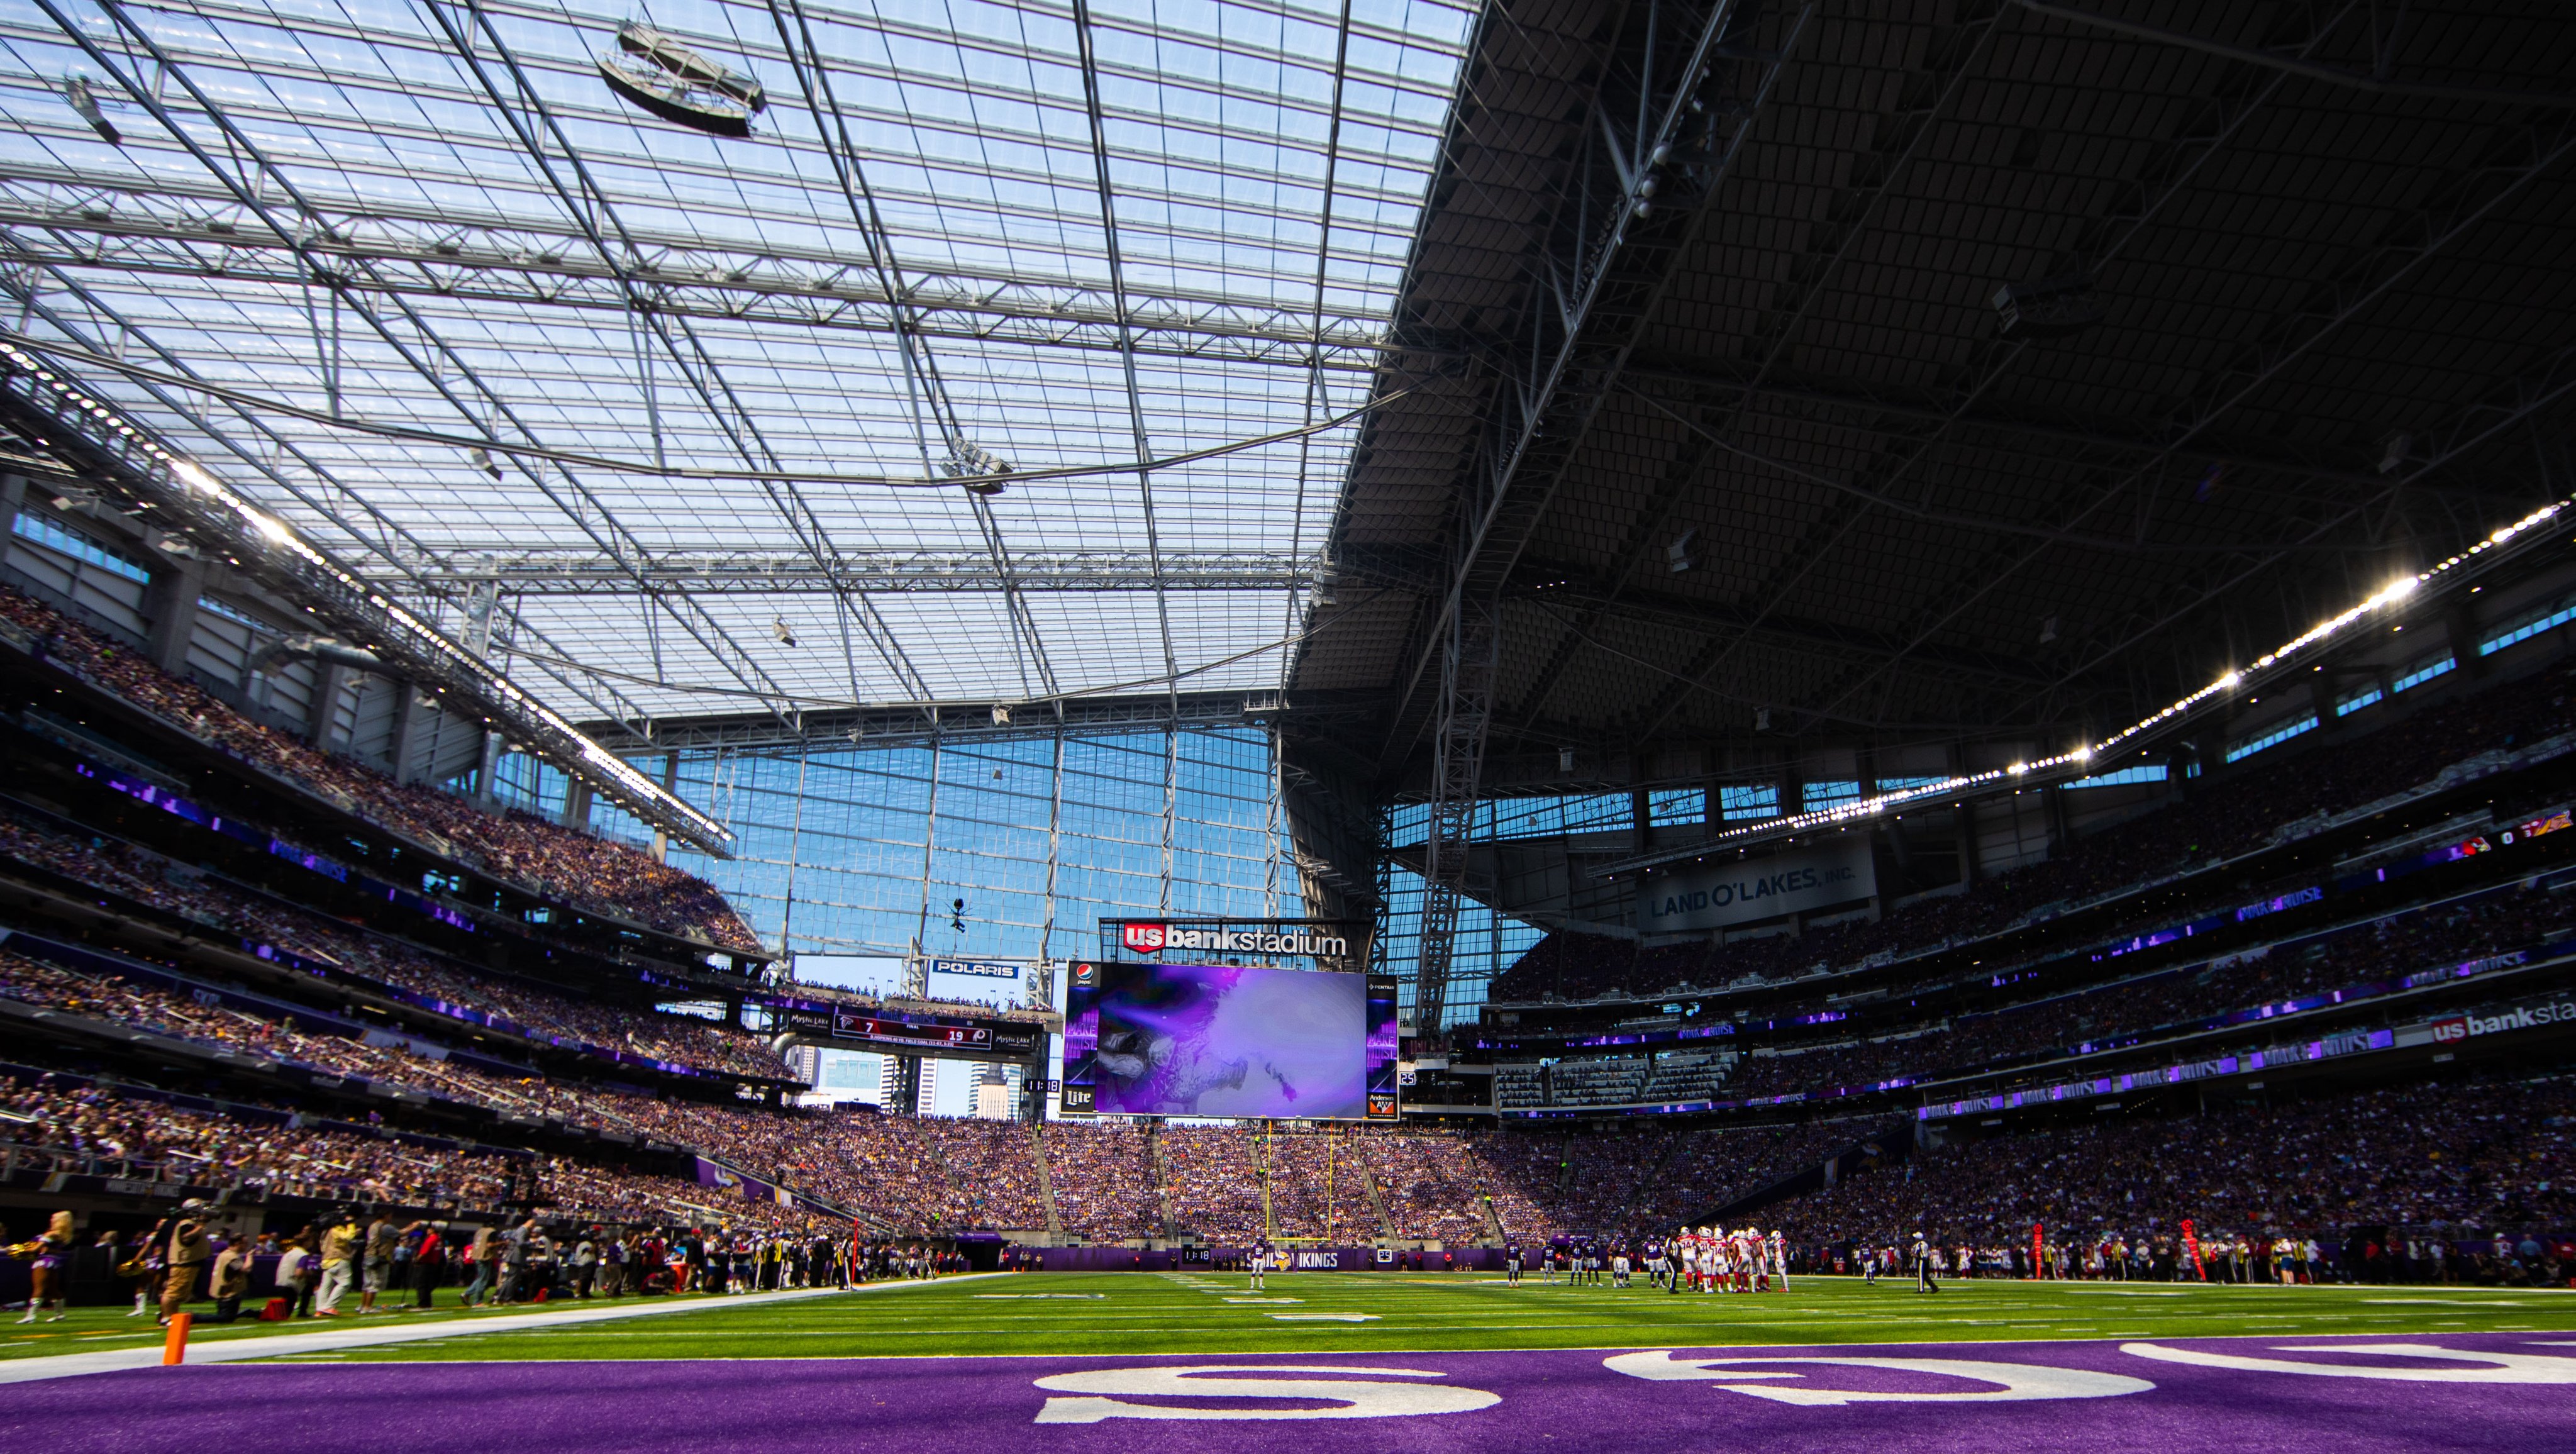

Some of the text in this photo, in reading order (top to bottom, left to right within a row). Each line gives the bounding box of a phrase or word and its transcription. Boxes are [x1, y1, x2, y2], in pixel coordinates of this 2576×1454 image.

[2501, 831, 2514, 845] 0
[1650, 867, 1857, 918] LAND O'LAKES, INC.
[1124, 923, 1163, 948] us
[937, 961, 1014, 978] POLARIS
[791, 1014, 813, 1024] Mystic
[865, 1022, 874, 1033] 7
[1680, 1024, 1735, 1040] MAKE NOISE
[948, 1031, 964, 1041] 19
[996, 1035, 1016, 1044] Mystic
[1401, 1073, 1414, 1084] 25
[1028, 1079, 1059, 1092] 11:18
[1066, 1090, 1091, 1107] Lite
[1681, 1241, 1692, 1250] 74
[1701, 1243, 1708, 1252] 31
[1714, 1246, 1722, 1255] 14
[1185, 1250, 1210, 1260] 11:18
[1379, 1250, 1391, 1261] 25
